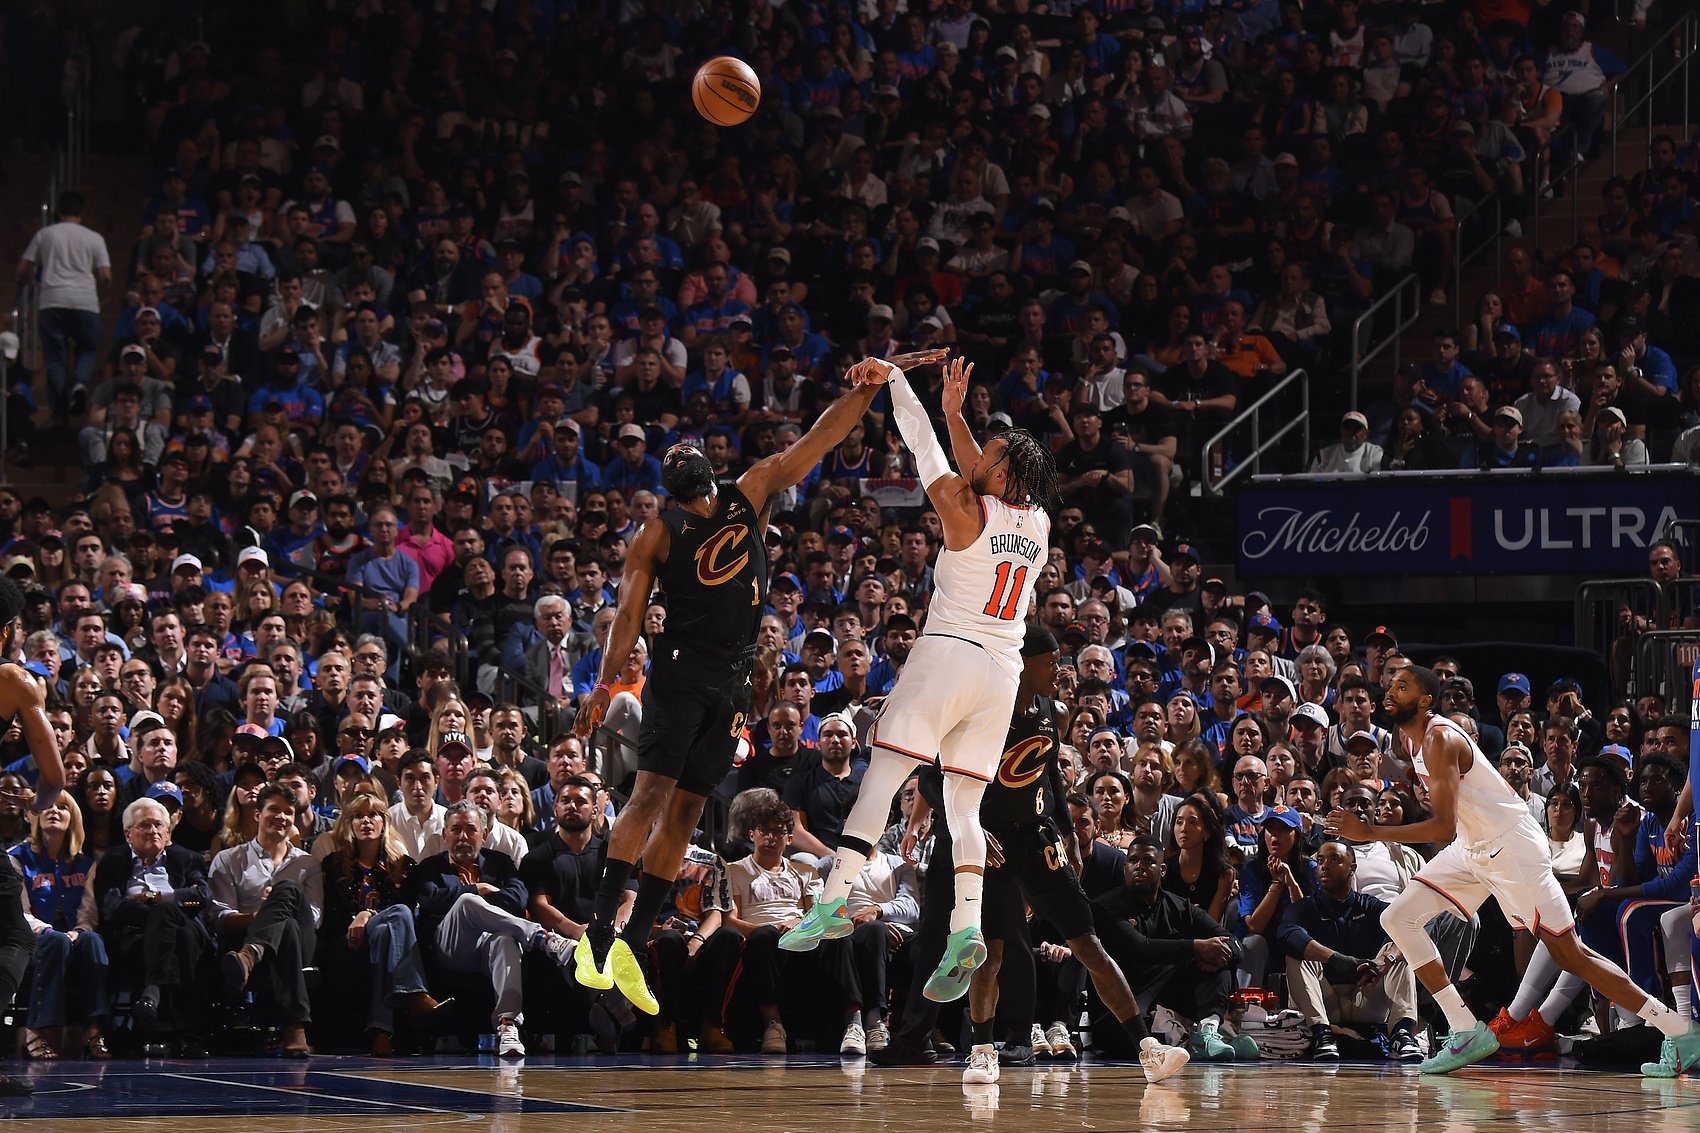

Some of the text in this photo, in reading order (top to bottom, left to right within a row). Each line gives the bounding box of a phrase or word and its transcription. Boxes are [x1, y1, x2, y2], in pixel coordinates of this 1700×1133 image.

[1241, 504, 1690, 560] Michelob ULTRA
[989, 533, 1042, 564] BRUNSON
[751, 575, 761, 607] 1
[982, 560, 1029, 621] 11
[444, 732, 466, 743] NYK
[1034, 786, 1046, 816] 8
[32, 872, 87, 891] NEW YOR
